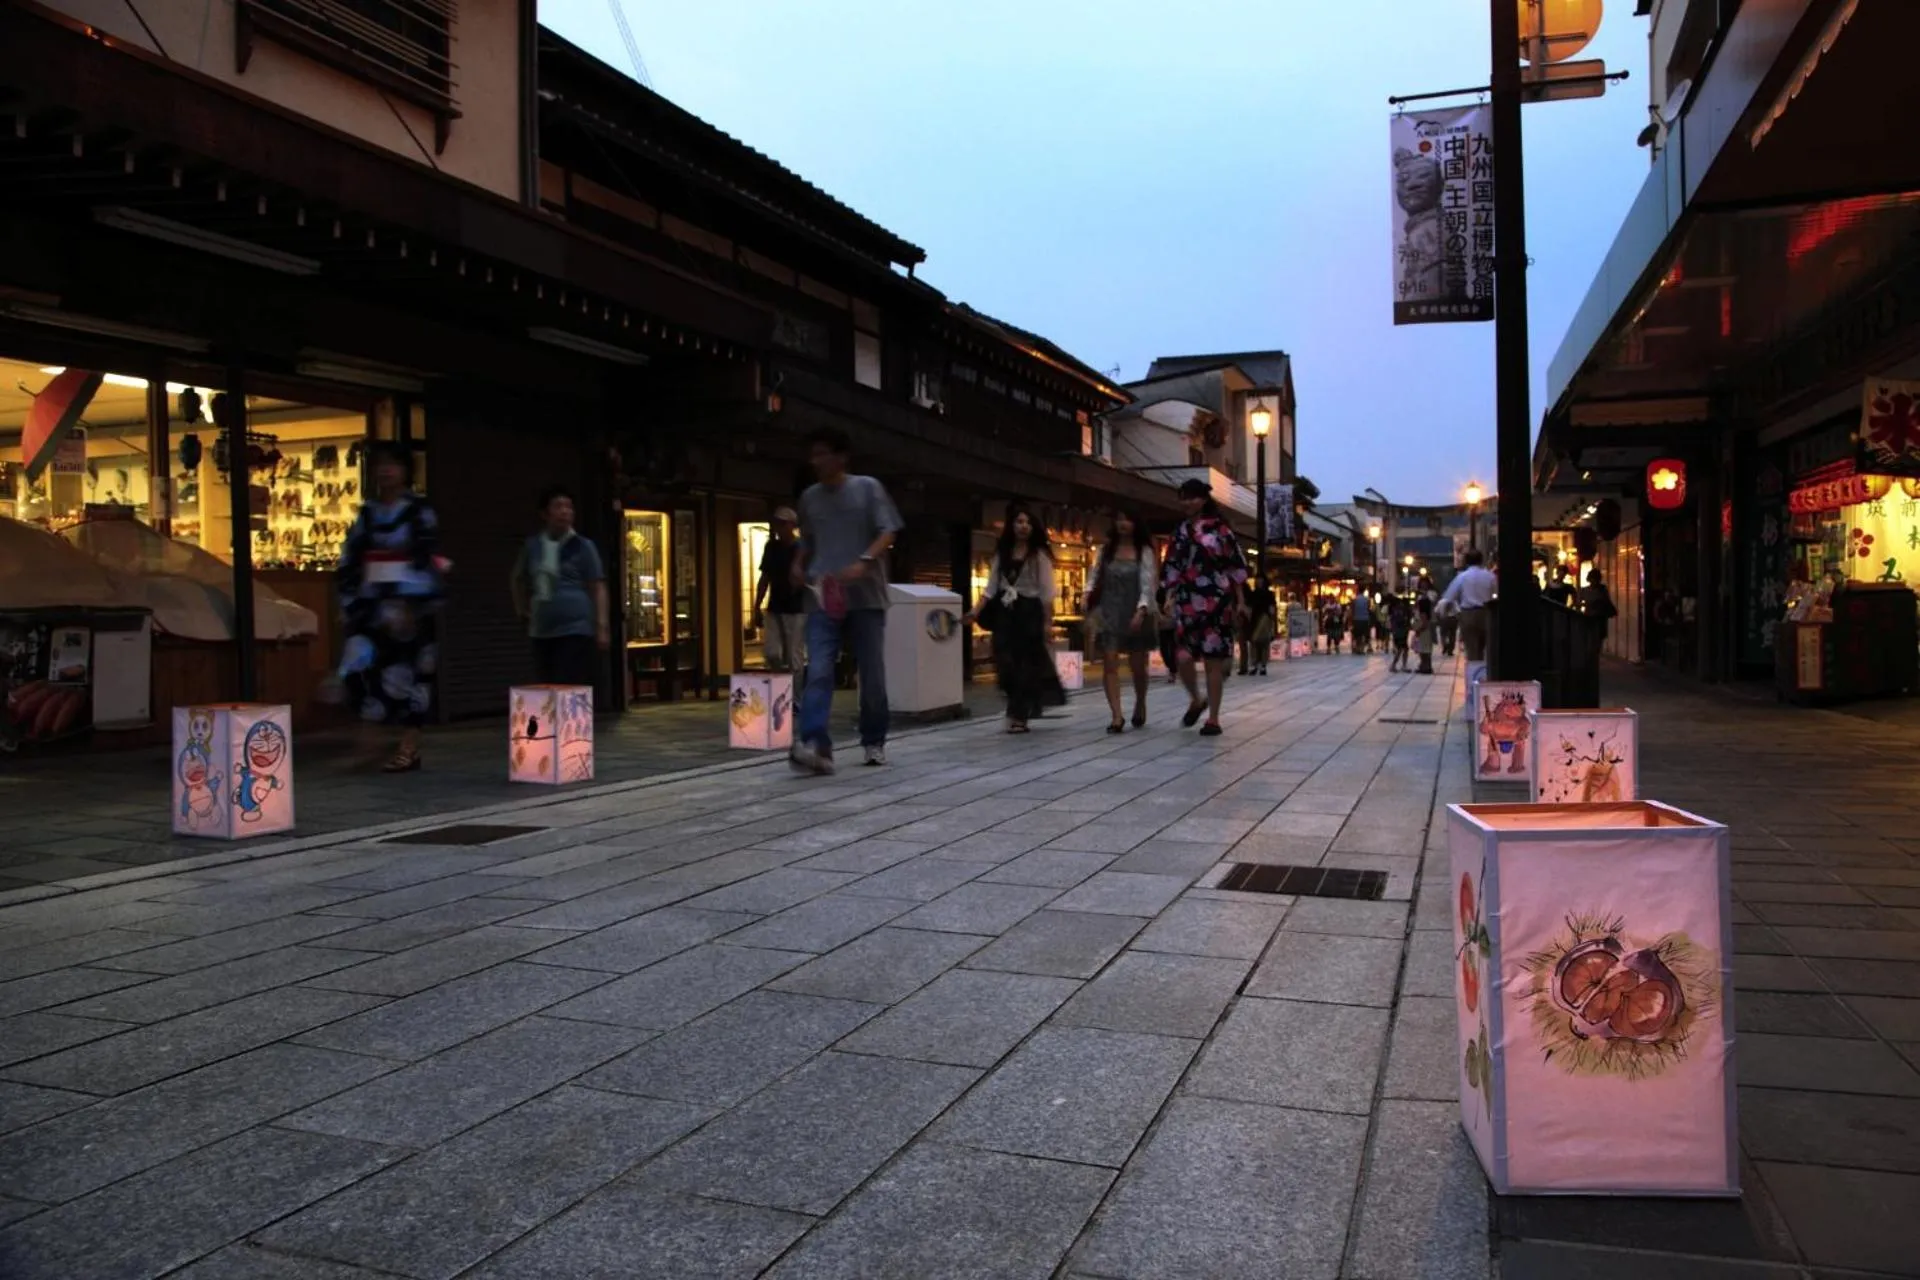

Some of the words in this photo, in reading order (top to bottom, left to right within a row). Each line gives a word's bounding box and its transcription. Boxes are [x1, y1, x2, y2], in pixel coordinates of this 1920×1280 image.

[1472, 132, 1495, 300] 九州国立博物館
